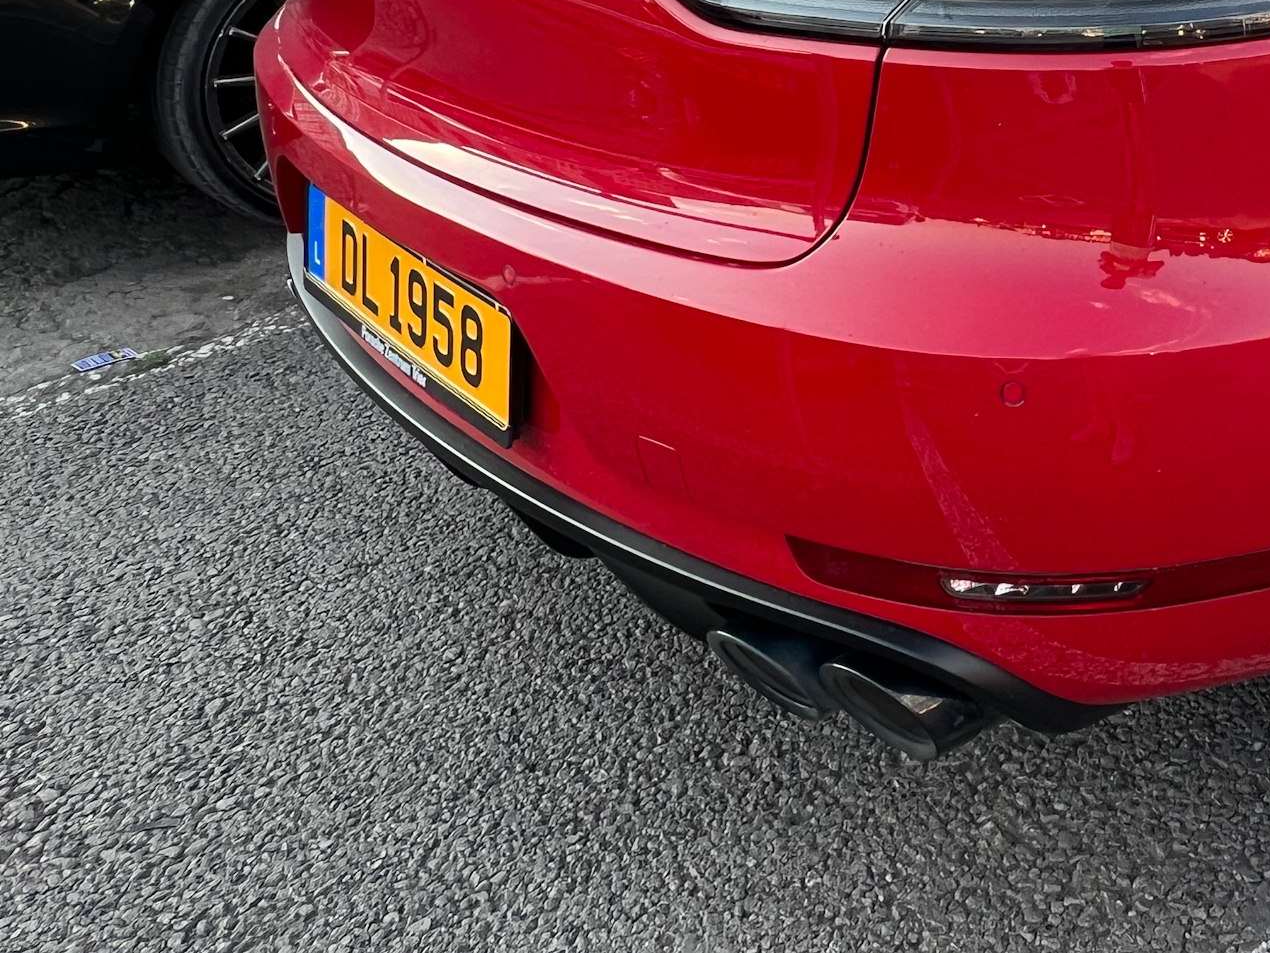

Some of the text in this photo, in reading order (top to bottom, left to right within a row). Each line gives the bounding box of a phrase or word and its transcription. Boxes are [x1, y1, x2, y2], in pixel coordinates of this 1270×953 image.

[314, 240, 321, 266] L
[341, 218, 483, 388] DL 1958
[361, 324, 385, 355] Porsche
[411, 363, 427, 388] Trier
